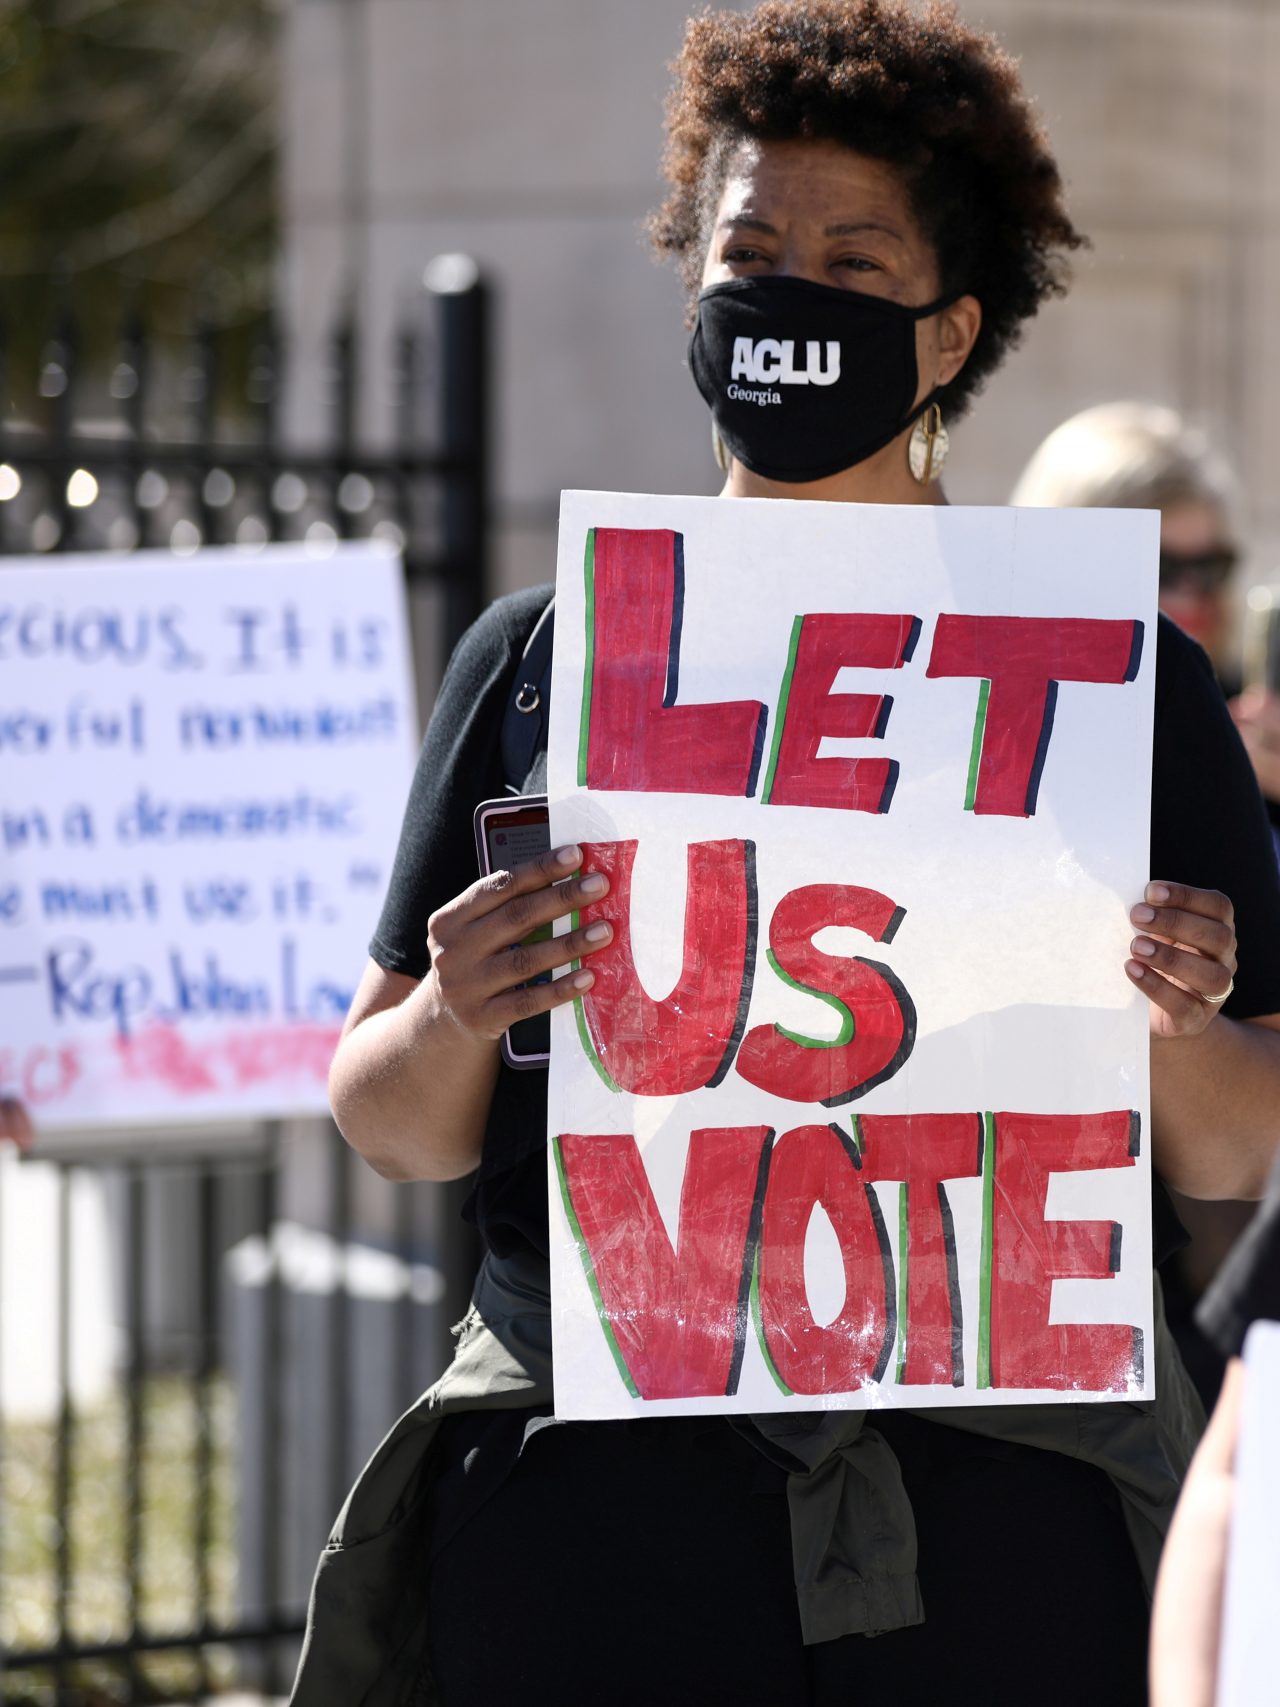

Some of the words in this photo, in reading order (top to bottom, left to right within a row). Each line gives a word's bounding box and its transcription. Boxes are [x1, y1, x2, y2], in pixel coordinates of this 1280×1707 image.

[727, 383, 782, 406] Georgia
[731, 336, 841, 386] ACLU
[221, 600, 307, 675] It
[577, 526, 1144, 818] LET
[0, 694, 145, 757] erful
[572, 838, 917, 1108] US
[552, 1110, 1144, 1400] VOTE
